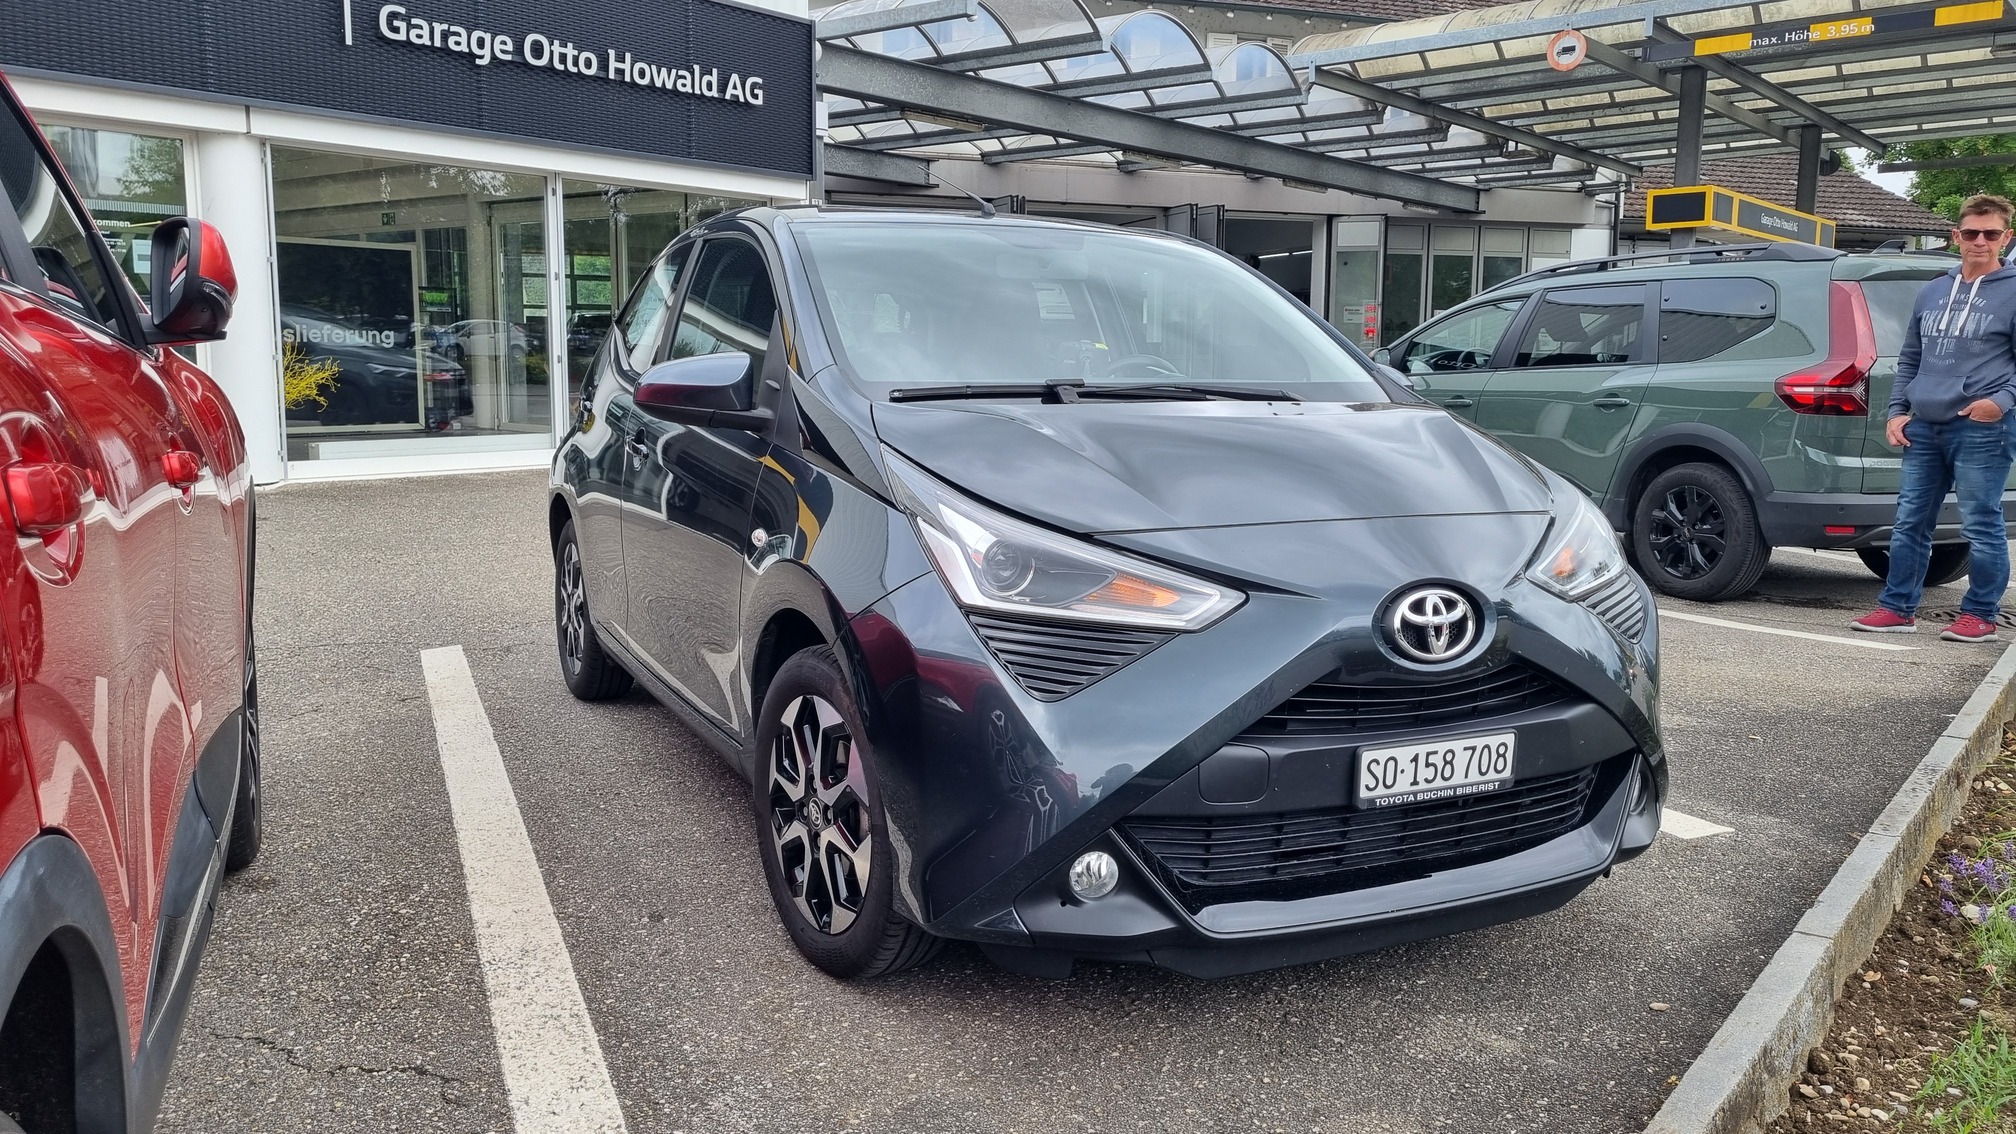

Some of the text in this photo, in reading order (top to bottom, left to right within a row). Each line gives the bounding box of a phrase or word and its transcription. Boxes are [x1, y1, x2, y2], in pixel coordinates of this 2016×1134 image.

[1748, 22, 1875, 47] max. Höhe 3,95 m
[378, 4, 764, 106] Garage Otto Howald AG
[1462, 741, 1509, 779] 708
[1375, 794, 1415, 806] TOYOTA
[1456, 781, 1500, 795] BIBERIST
